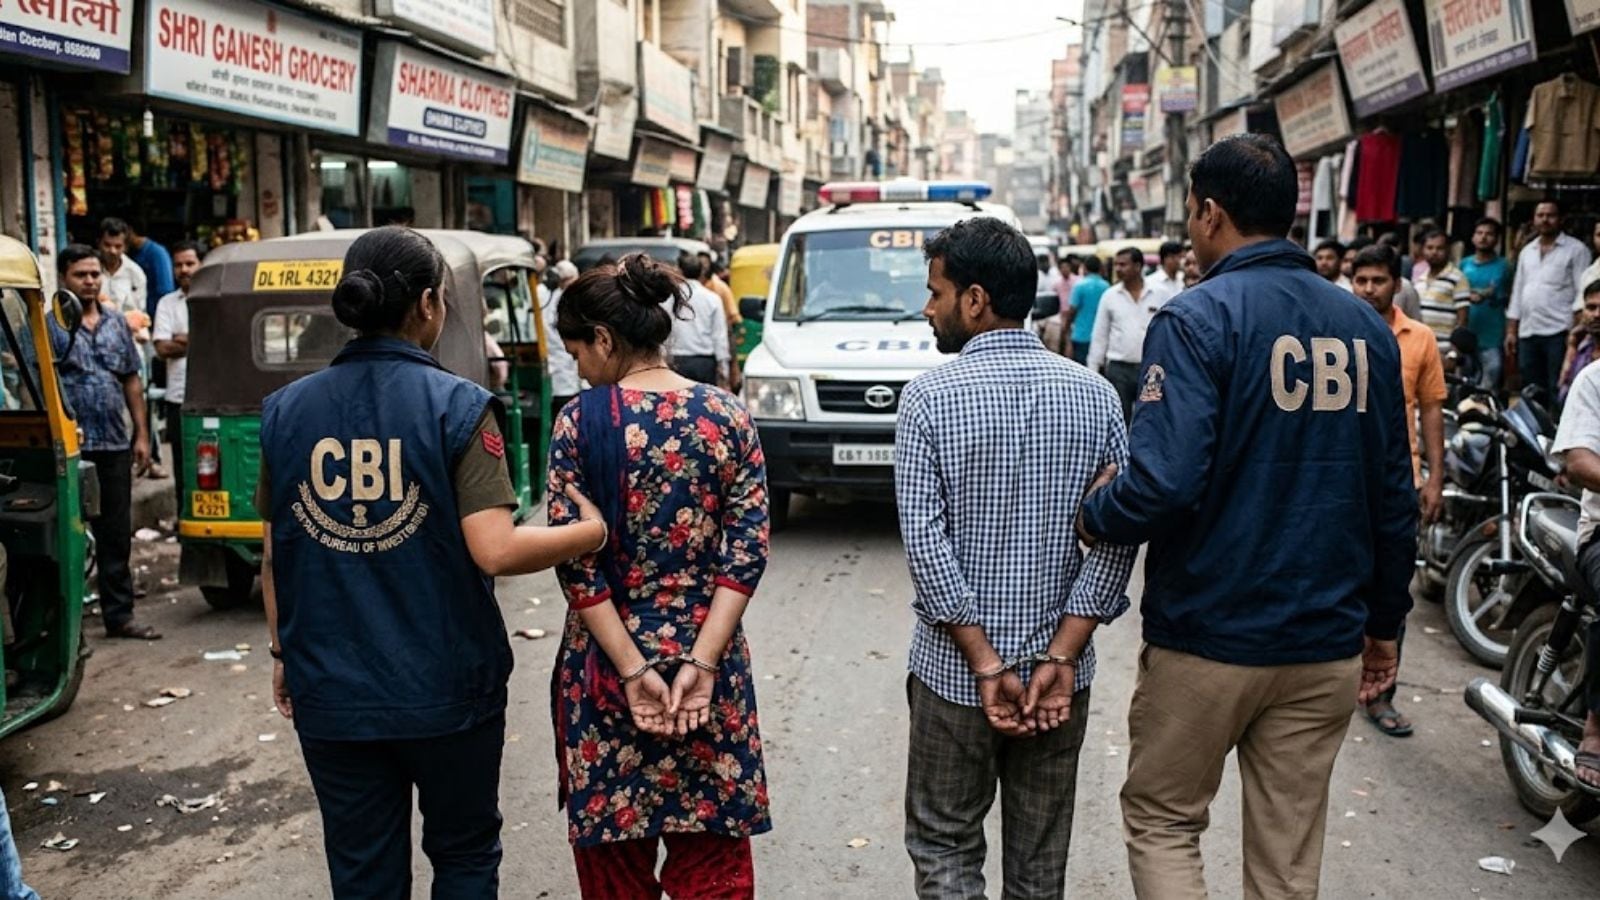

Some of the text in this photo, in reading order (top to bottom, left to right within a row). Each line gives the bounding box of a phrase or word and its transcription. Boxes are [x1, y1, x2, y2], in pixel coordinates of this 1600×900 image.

[159, 8, 206, 57] SHRI
[212, 24, 283, 76] GANESH
[288, 46, 357, 94] GROCERY
[398, 61, 511, 119] SHARMA CLOTHES
[870, 230, 923, 249] CBI
[258, 269, 339, 286] DL 1RL 4321
[835, 341, 930, 351] CBI
[1270, 334, 1369, 413] CBI
[310, 437, 404, 501] CBI
[320, 532, 360, 553] BUREAU
[362, 541, 377, 553] OF
